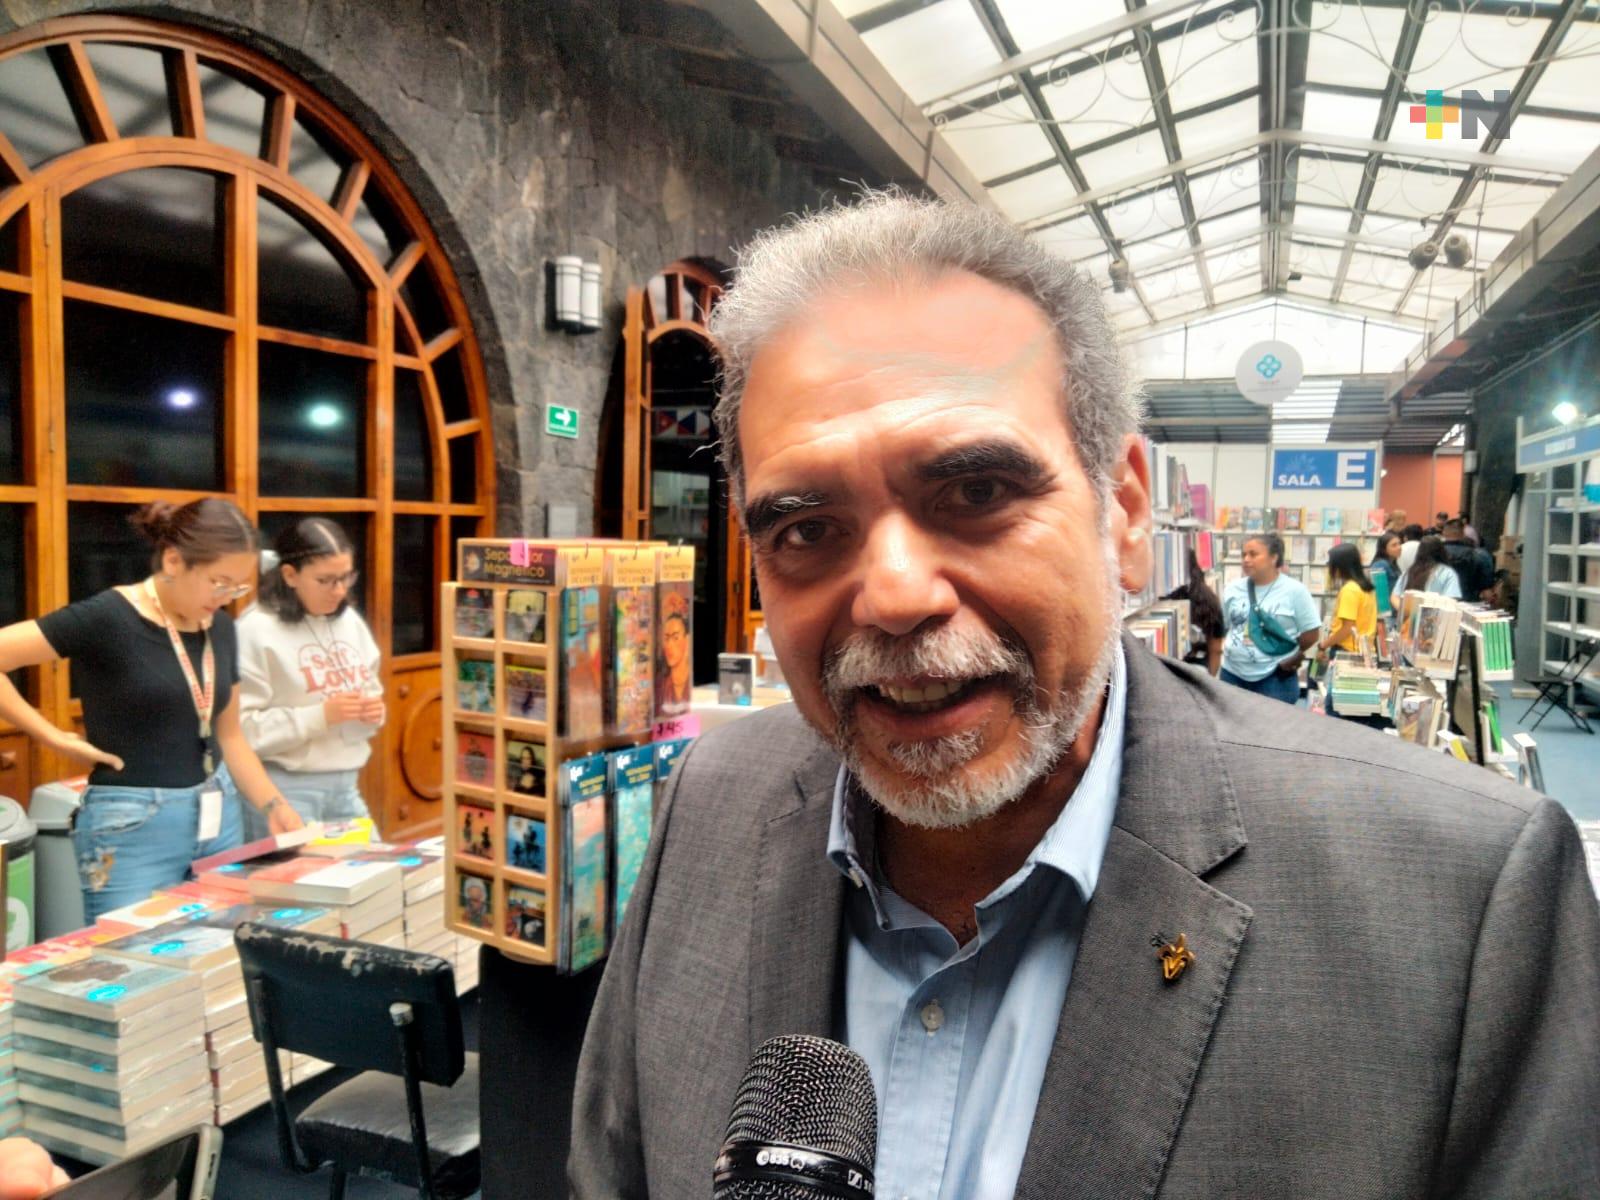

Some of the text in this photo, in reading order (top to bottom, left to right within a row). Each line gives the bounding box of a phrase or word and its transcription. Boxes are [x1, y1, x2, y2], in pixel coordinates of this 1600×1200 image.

[1278, 451, 1368, 488] SALA E
[299, 664, 371, 694] Love
